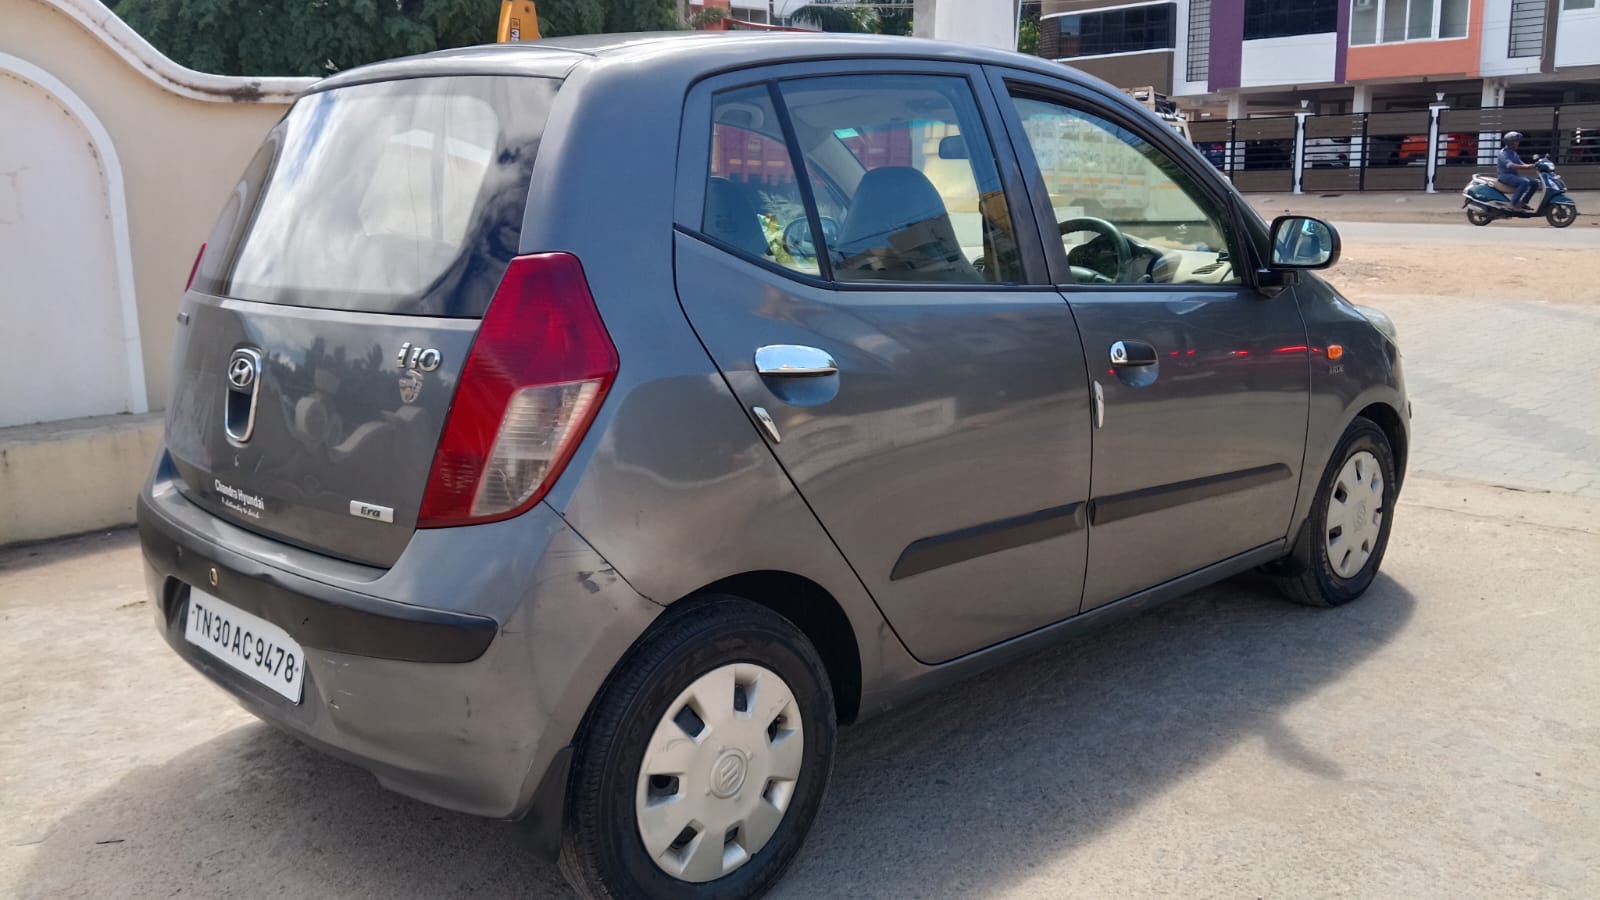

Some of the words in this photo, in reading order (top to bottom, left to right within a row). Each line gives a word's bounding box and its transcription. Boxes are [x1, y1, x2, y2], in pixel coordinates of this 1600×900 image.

[237, 488, 265, 510] Hyundai
[360, 506, 381, 518] Era
[195, 603, 295, 683] TN30AC9478
